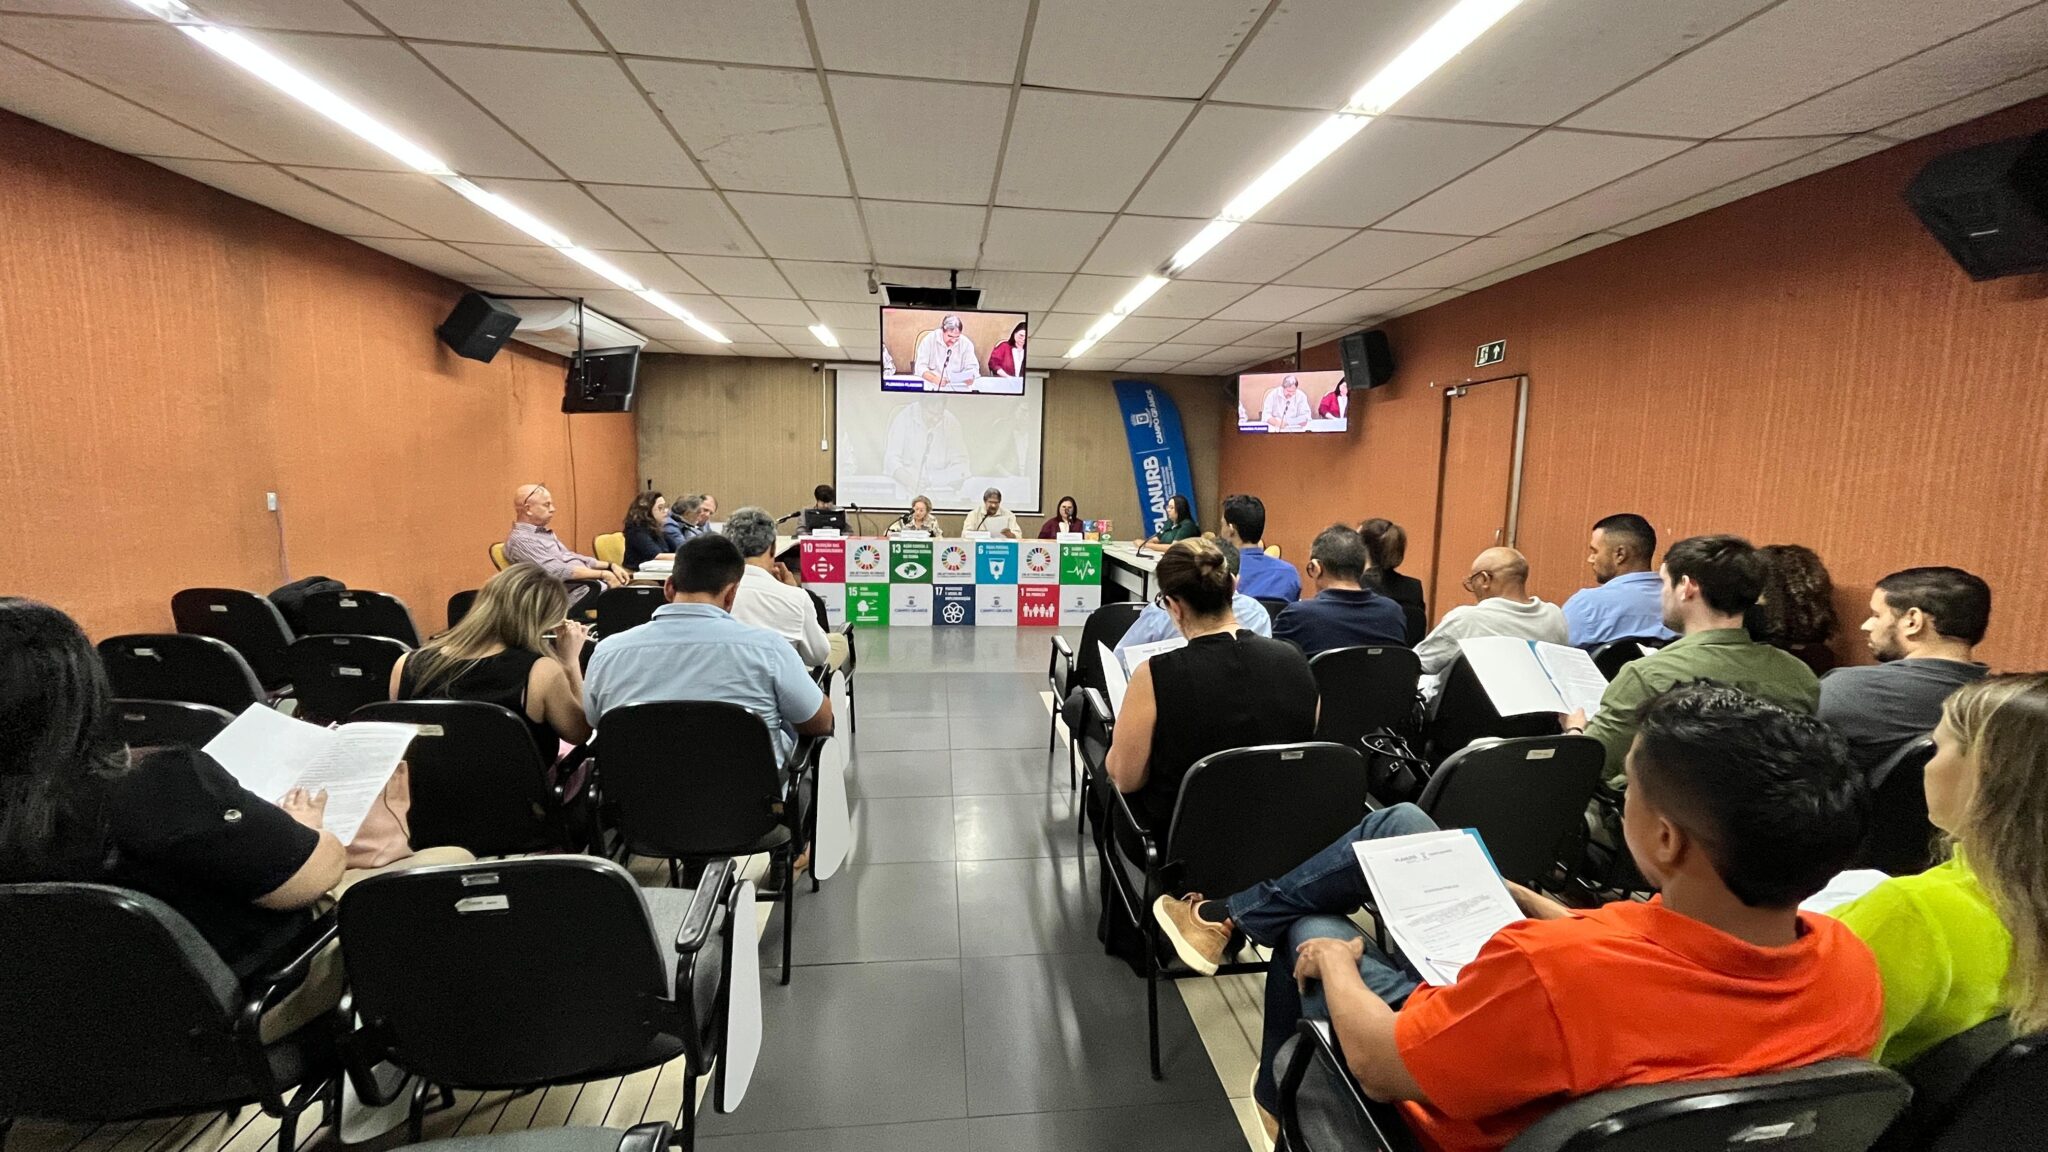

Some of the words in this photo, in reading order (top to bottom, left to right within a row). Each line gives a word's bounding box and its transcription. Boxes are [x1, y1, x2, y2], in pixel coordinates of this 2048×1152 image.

[1145, 388, 1158, 417] GRANDE
[1153, 418, 1164, 445] CAMPO
[1143, 455, 1168, 534] PLANURB
[803, 543, 813, 553] 10
[892, 544, 902, 553] 13
[978, 545, 984, 554] 6
[1063, 547, 1069, 556] 3
[848, 586, 858, 597] 15
[935, 586, 943, 596] 17
[1020, 587, 1024, 597] 1
